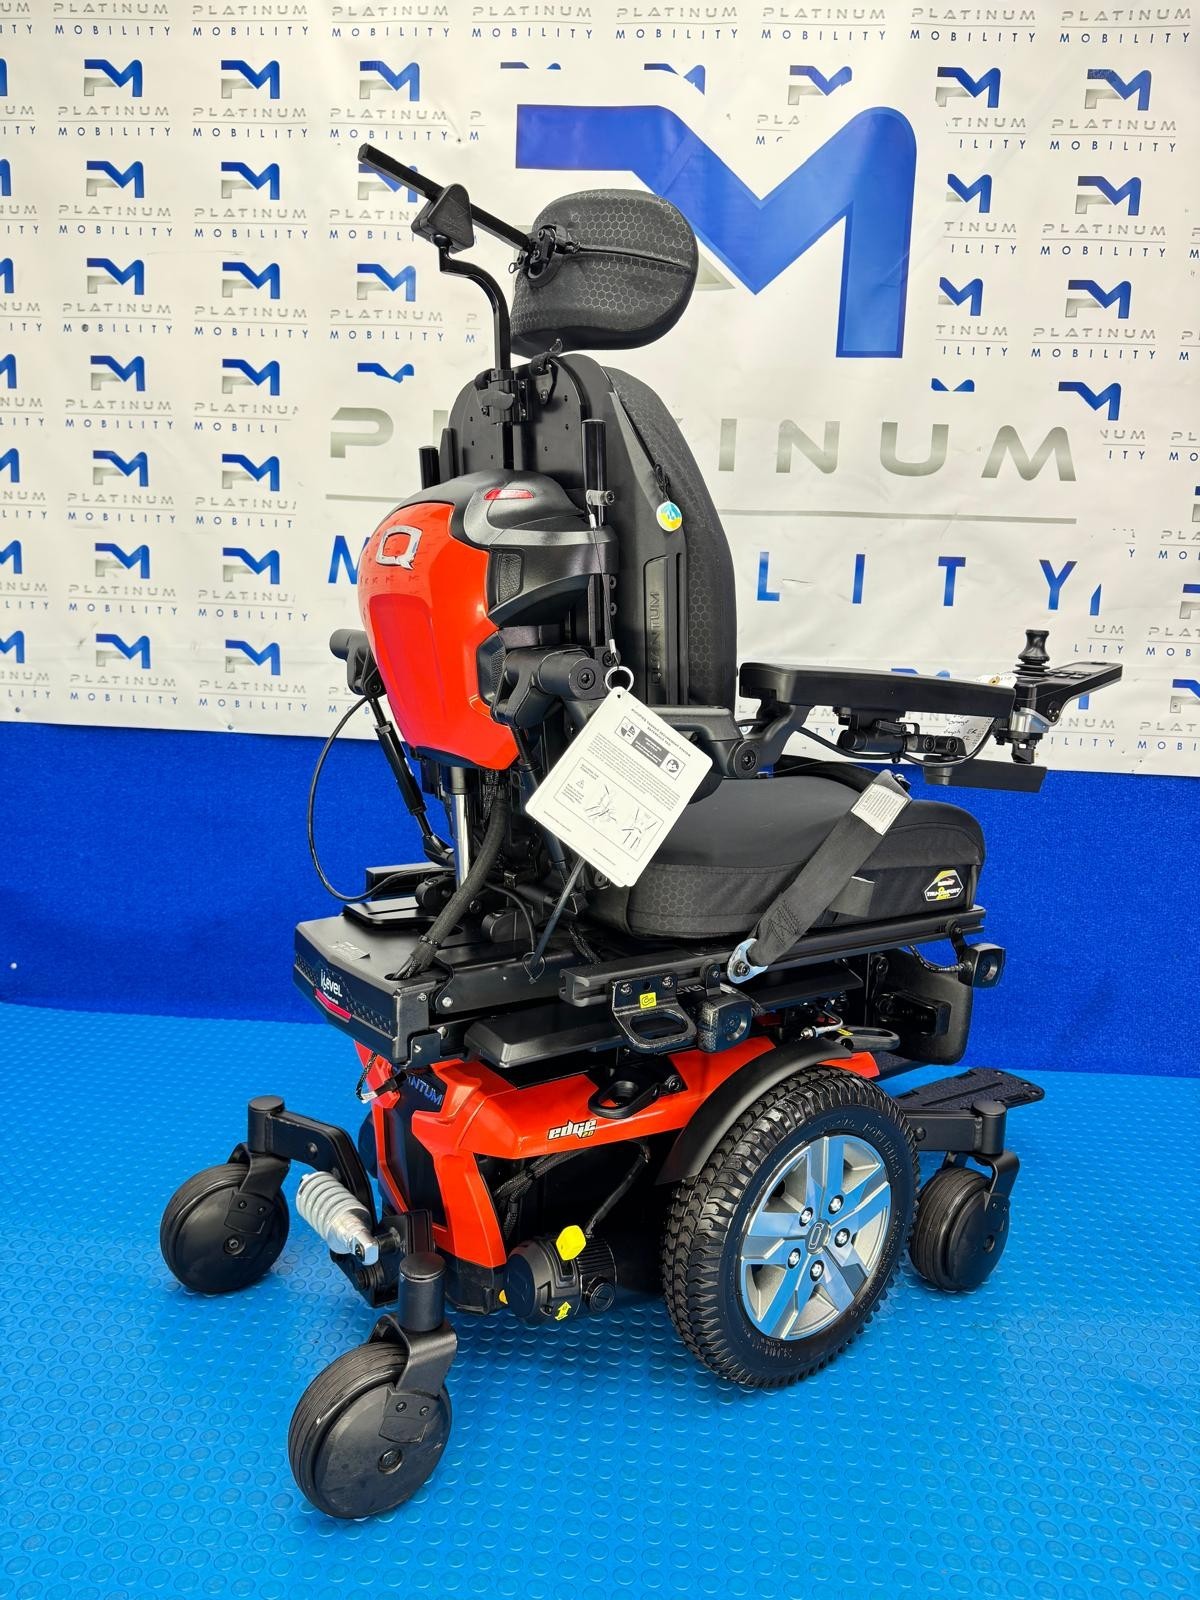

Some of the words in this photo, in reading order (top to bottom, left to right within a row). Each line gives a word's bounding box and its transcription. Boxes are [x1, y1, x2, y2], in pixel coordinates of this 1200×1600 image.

[52, 2, 169, 15] PLATINUM
[192, 4, 308, 16] PLATINUM
[331, 5, 449, 17] PLATINUM
[472, 5, 592, 18] PLATINUM
[616, 6, 738, 19] PLATINUM
[762, 6, 886, 19] PLATINUM
[911, 7, 1036, 21] PLATINUM
[1061, 7, 1192, 22] PLATINUM
[54, 24, 171, 37] MOBILITY
[192, 25, 309, 37] MOBILITY
[331, 26, 450, 38] MOBILITY
[471, 27, 593, 40] MOBILITY
[615, 28, 738, 40] MOBILITY
[761, 28, 886, 41] MOBILITY
[909, 29, 1036, 43] MOBILITY
[1059, 32, 1190, 44] MOBILITY
[57, 105, 170, 117] PLATINUM
[192, 107, 307, 119] PLATINUM
[329, 107, 447, 121] PLATINUM
[945, 116, 1027, 129] TINUM
[1051, 118, 1177, 132] PLATINUM
[57, 126, 171, 137] MOBILITY
[192, 127, 308, 139] MOBILITY
[329, 128, 448, 141] MOBILITY
[1049, 140, 1176, 153] MOBILITY
[58, 204, 172, 217] PLATINUM
[194, 207, 307, 220] PLATINUM
[58, 224, 173, 237] MOBILITY
[194, 228, 309, 239] MOBILITY
[1042, 223, 1166, 237] PLATINUM
[1039, 244, 1166, 260] MOBILITY
[62, 302, 172, 314] PLATINUM
[194, 305, 308, 319] PLATINUM
[329, 308, 443, 322] PLATINUM
[63, 323, 173, 334] MOBILITY
[194, 326, 309, 339] MOBILITY
[1032, 327, 1156, 340] PLATINUM
[329, 330, 444, 342] MOBILITY
[1030, 347, 1156, 360] MOBILITY
[64, 398, 172, 411] PLATINUM
[65, 418, 174, 430] MOBILITY
[67, 492, 174, 505] PLATINUM
[67, 511, 176, 524] MOBILITY
[68, 584, 176, 597] PLATINUM
[68, 603, 178, 616] MOBILITY
[198, 608, 308, 622] MOBILITY
[69, 673, 175, 687] PLATINUM
[200, 679, 306, 692] PLATINUM
[70, 692, 178, 705] MOBILITY
[199, 698, 308, 712] MOBILITY
[548, 1119, 597, 1140] edge
